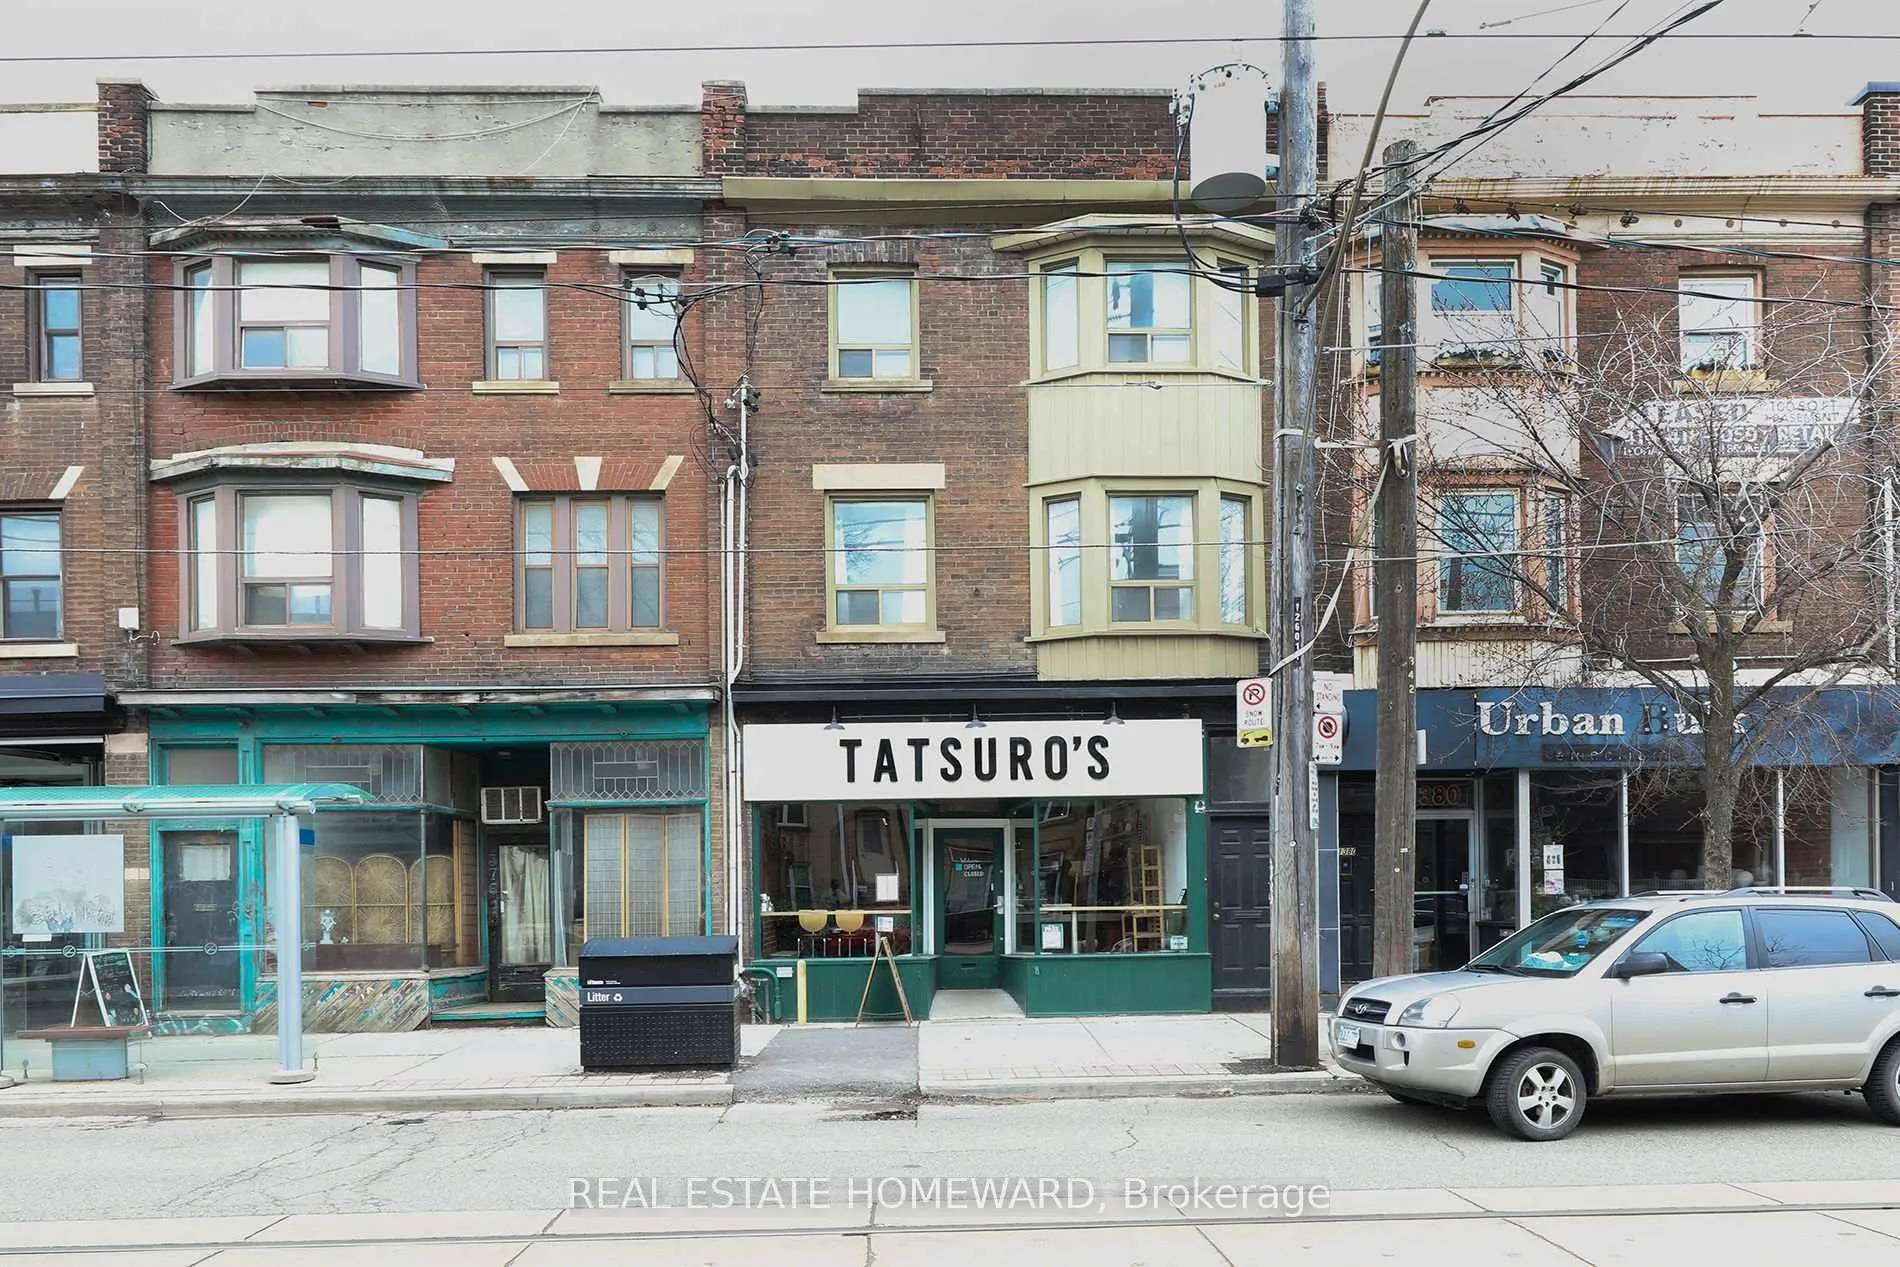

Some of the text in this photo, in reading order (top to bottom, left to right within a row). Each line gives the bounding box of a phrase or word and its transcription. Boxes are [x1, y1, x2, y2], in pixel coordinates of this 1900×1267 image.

[1243, 718, 1264, 727] ROUTE
[1476, 701, 1626, 736] Urban
[839, 735, 1110, 783] TATSURO'S
[587, 991, 610, 1002] Litter
